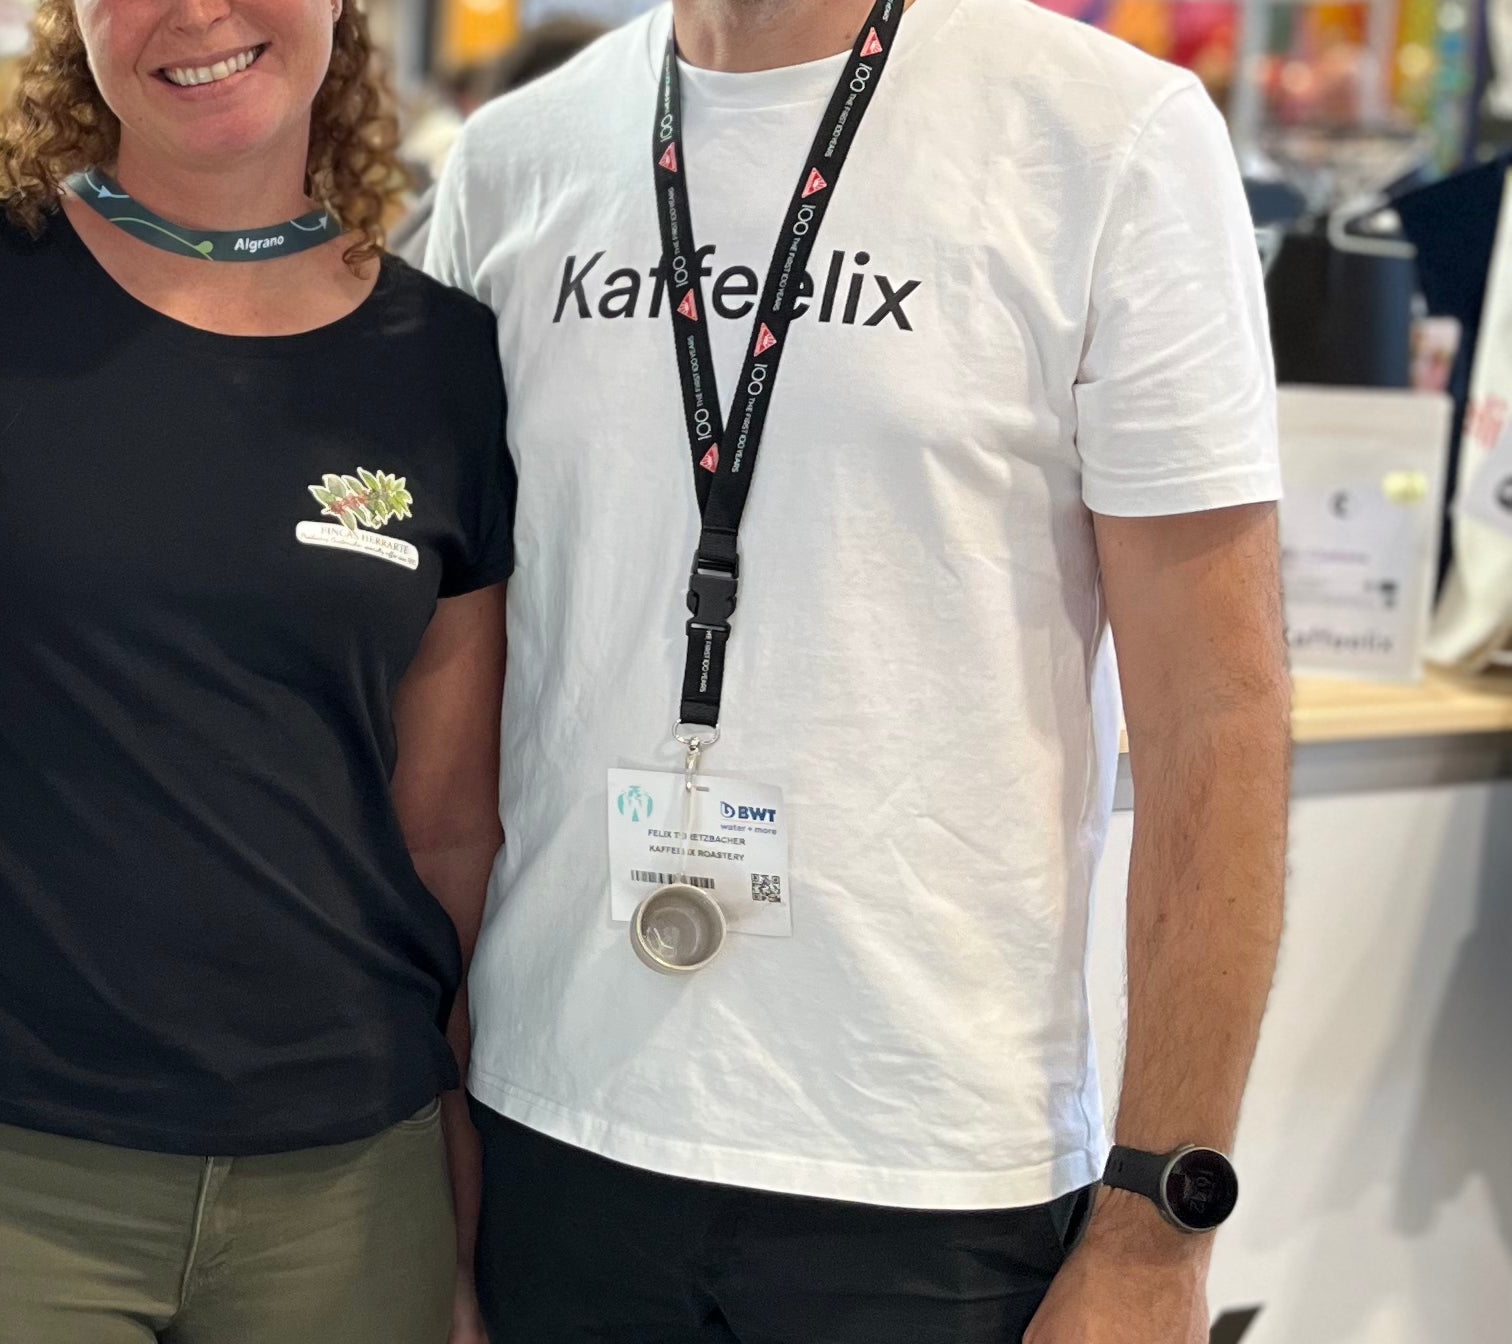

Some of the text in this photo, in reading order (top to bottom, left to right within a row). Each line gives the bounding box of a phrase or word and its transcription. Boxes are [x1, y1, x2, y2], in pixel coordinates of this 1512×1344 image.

[848, 61, 873, 94] 100
[659, 113, 673, 142] 100
[791, 201, 816, 237] 100
[233, 235, 284, 253] Algrano
[672, 255, 689, 287] 100
[746, 361, 768, 397] 100
[693, 407, 712, 441] 100
[738, 806, 776, 823] BWT
